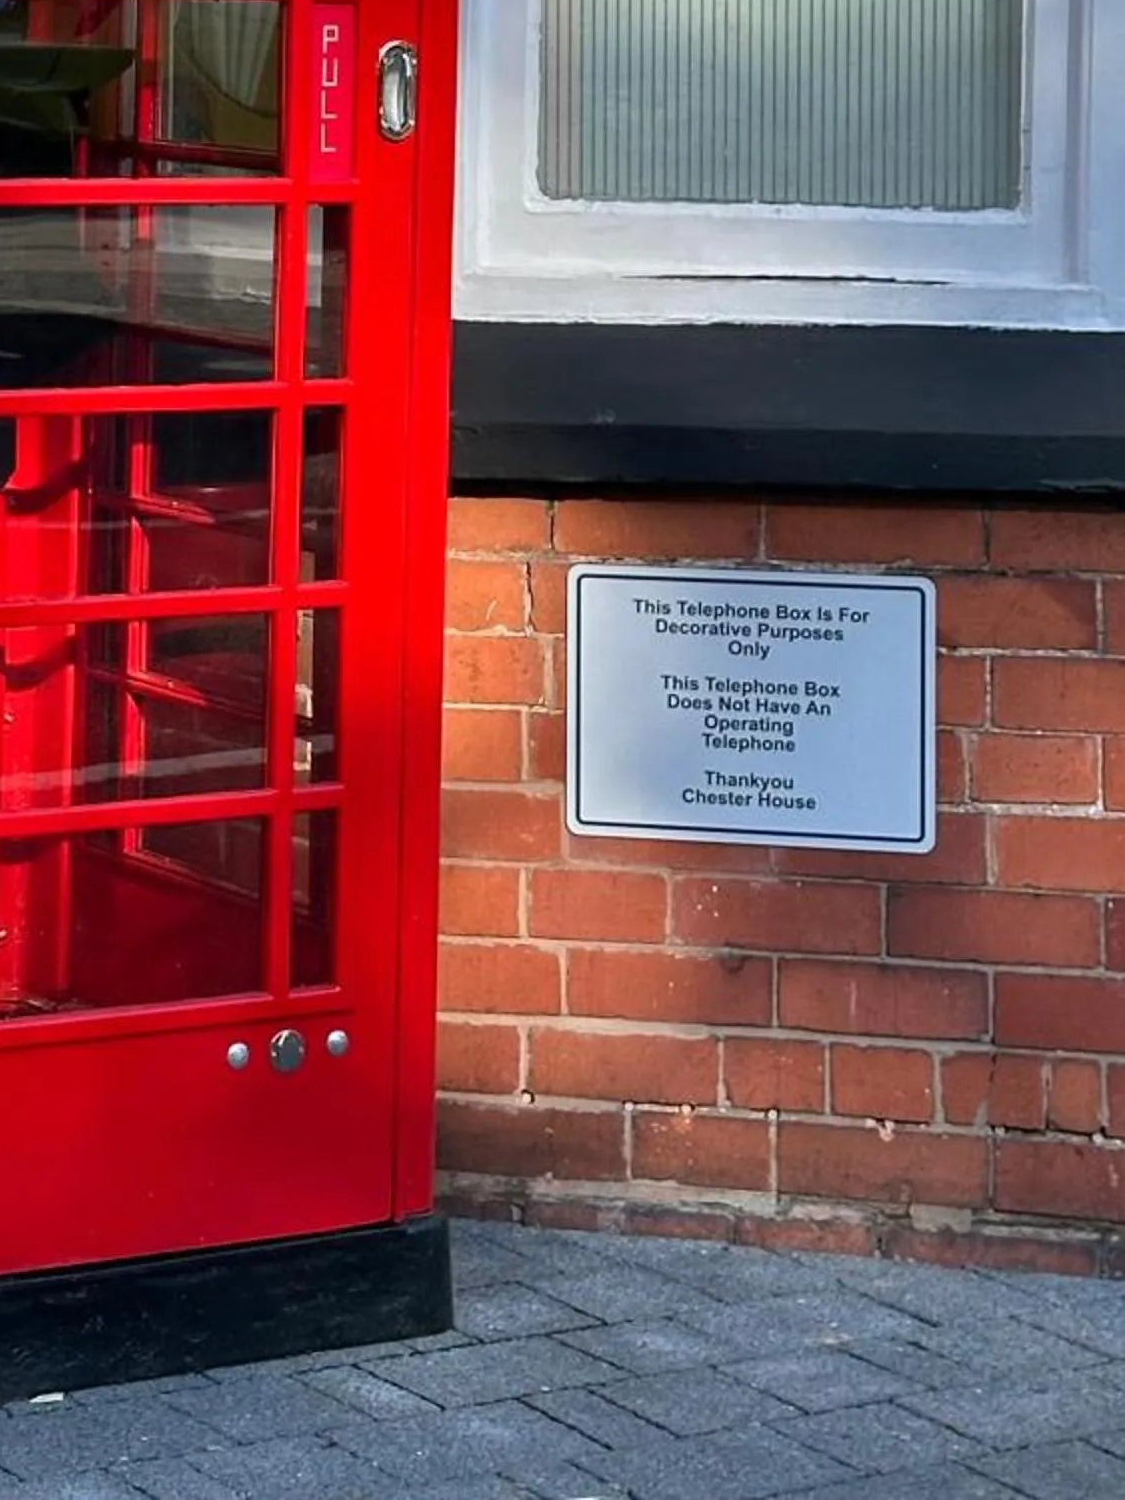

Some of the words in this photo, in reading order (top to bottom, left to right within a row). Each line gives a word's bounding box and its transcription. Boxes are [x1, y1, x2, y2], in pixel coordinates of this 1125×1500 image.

[321, 25, 339, 152] PULL
[633, 598, 671, 615] This
[676, 600, 770, 621] Telephone
[776, 604, 812, 621] Box
[817, 606, 833, 622] Is
[838, 607, 870, 623] For
[655, 618, 752, 637] Decorative
[757, 622, 843, 642] Purposes
[728, 639, 771, 660] Only
[660, 675, 699, 691] This
[704, 676, 799, 697] Telephone
[804, 681, 840, 698] Box
[667, 693, 713, 711] Does
[718, 696, 751, 713] Not
[755, 697, 801, 715] Have
[805, 700, 831, 716] An
[704, 713, 794, 737] Operating
[701, 732, 795, 753] Telephone
[704, 770, 794, 792] Thankyou
[682, 788, 753, 807] Chester
[758, 791, 816, 810] House
